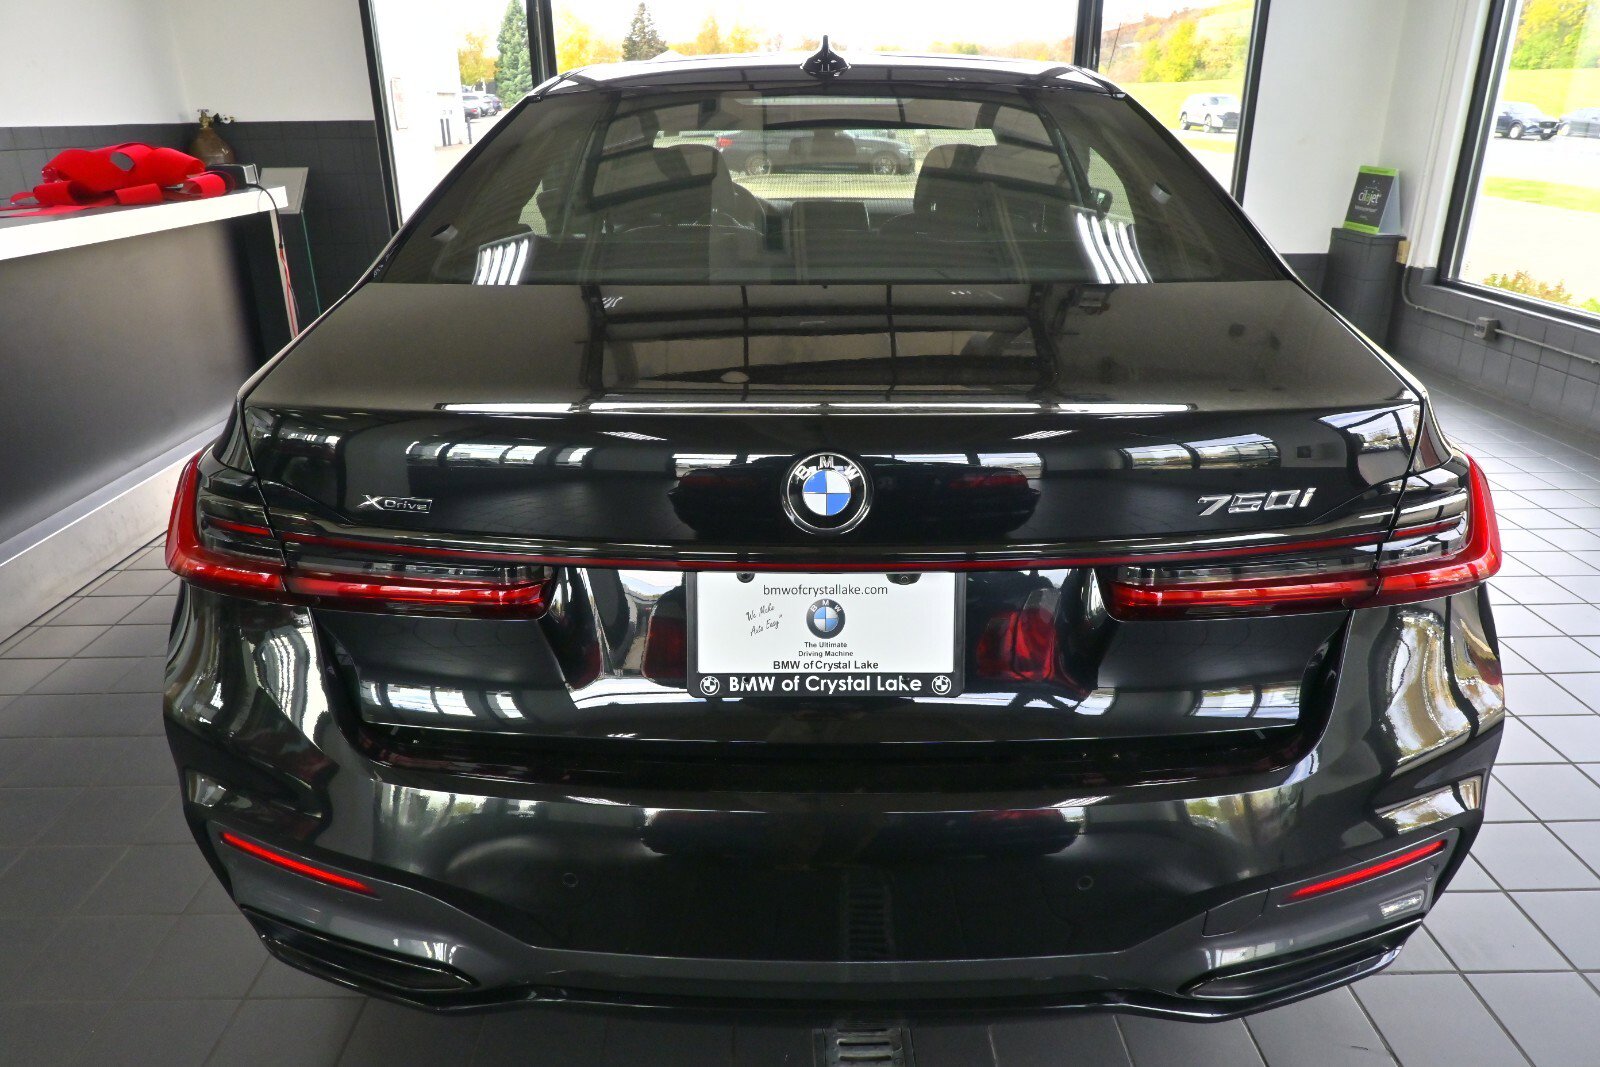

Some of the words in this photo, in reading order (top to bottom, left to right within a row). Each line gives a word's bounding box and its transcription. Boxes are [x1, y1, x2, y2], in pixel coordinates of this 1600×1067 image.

[794, 456, 860, 480] BMW
[1198, 487, 1316, 516] 750i
[763, 584, 888, 597] bmwofcrystallake.com
[810, 600, 842, 613] BMW
[798, 650, 823, 658] Driving
[773, 660, 800, 670] BMW
[803, 660, 814, 670] of
[815, 660, 851, 671] Crystal
[854, 660, 879, 670] Lake
[729, 676, 776, 692] BMW
[781, 675, 800, 692] of
[805, 675, 870, 695] Crystal
[877, 675, 922, 691] Lake
